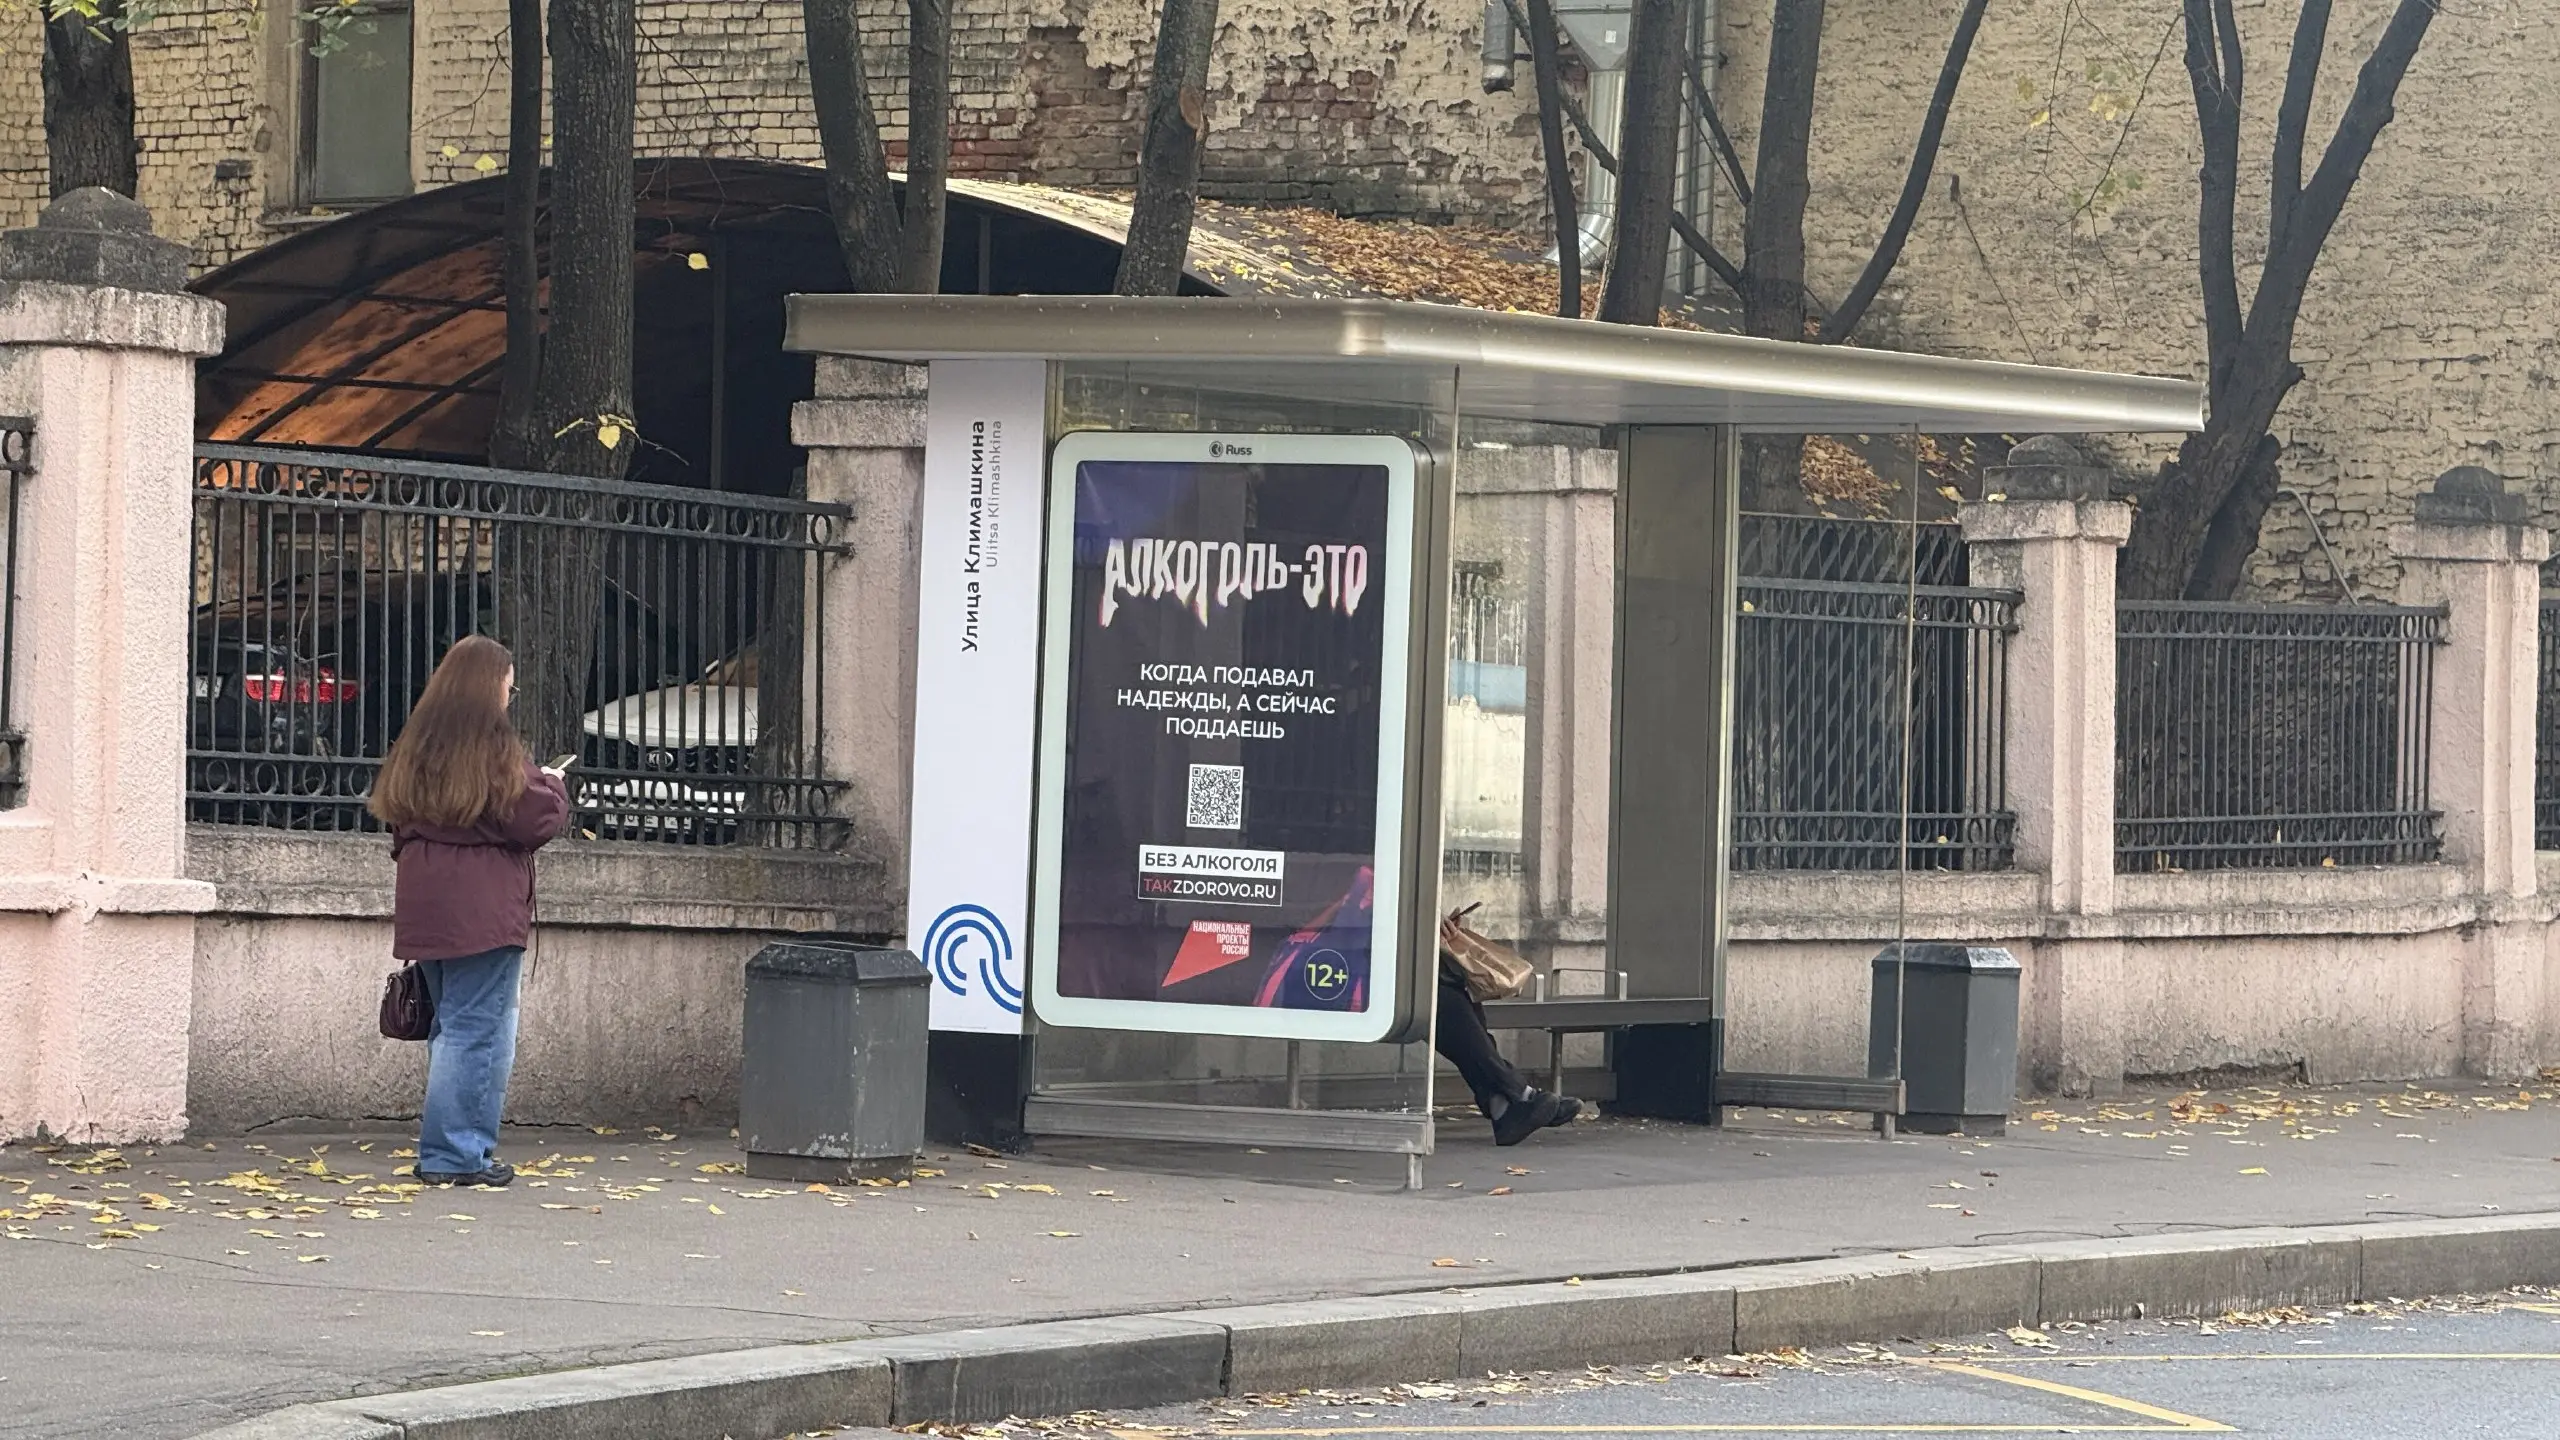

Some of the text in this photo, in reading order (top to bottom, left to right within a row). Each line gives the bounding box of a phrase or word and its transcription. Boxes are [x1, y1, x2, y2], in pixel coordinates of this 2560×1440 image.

[1225, 444, 1253, 456] Russ
[985, 420, 1002, 568] Ulitsa Klimashkina
[961, 420, 985, 653] Улица Климашкина
[1140, 663, 1314, 688] КОГДА ПОДАВАЛ
[1117, 688, 1336, 715] НАДЕЖДЫ, А СЕЙЧАС
[1166, 717, 1286, 740] ПОДДАЕШЬ
[1144, 852, 1278, 874] БЕЗ АЛКОГОЛЯ
[1143, 877, 1277, 900] TAKZDOROVO.RU
[1192, 920, 1251, 934] НАЦИОНАЛЬНЫЕ
[1216, 933, 1250, 945] ПРОЕКТЫ
[1221, 944, 1249, 955] РОССИИ
[1307, 963, 1348, 988] 12+
